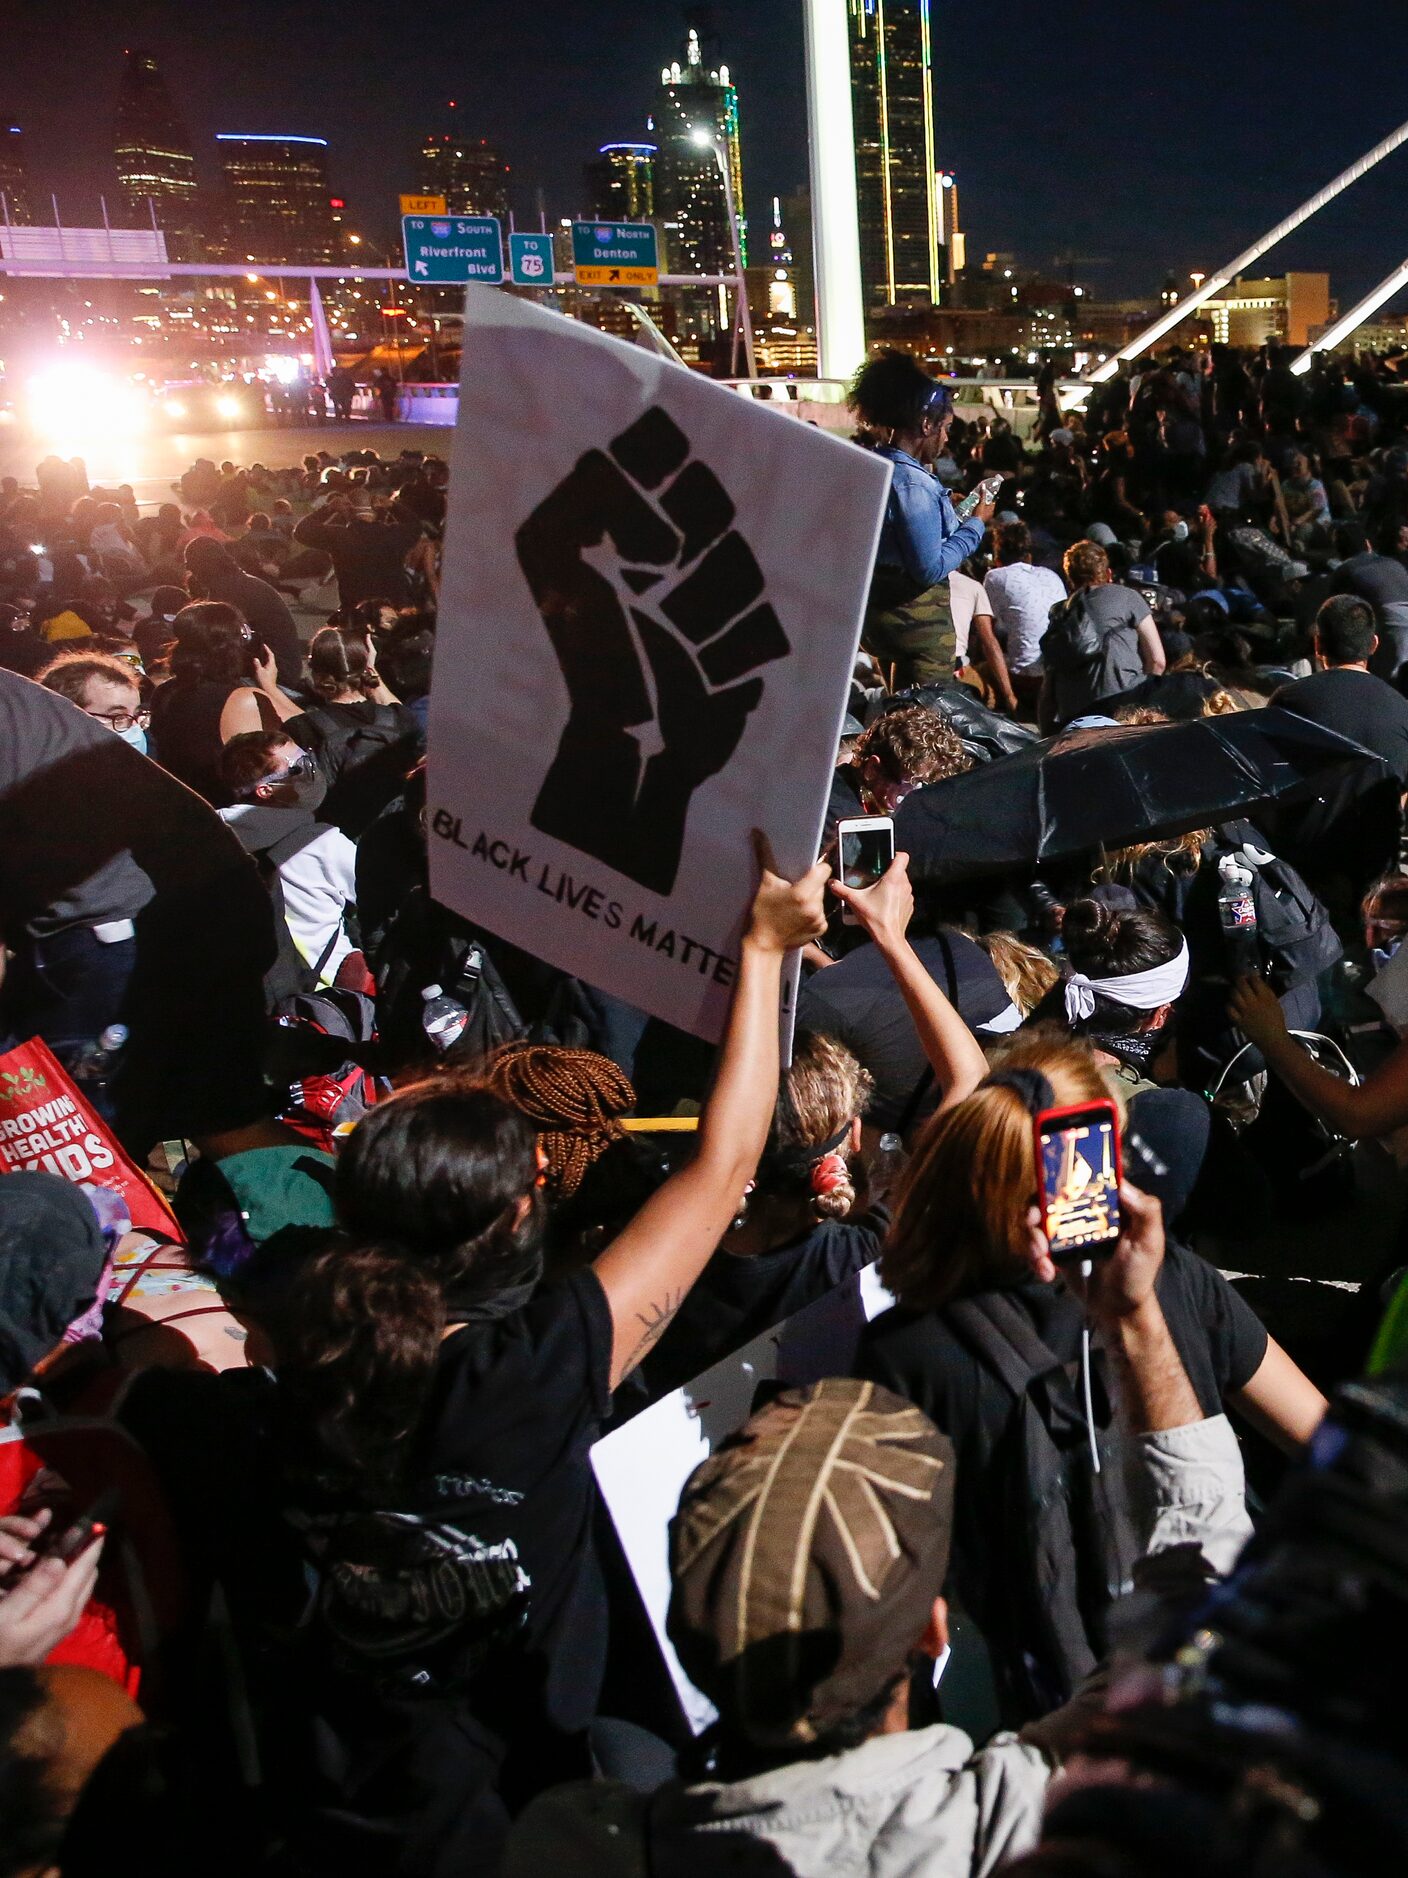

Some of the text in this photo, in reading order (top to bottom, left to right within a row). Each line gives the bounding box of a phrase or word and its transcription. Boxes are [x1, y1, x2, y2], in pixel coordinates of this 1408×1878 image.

[409, 200, 437, 210] LEFT
[411, 220, 425, 230] TO
[456, 221, 493, 235] SOUTH
[578, 226, 591, 236] TO
[616, 227, 650, 240] NORTH
[420, 245, 488, 259] Riverfront
[523, 240, 539, 251] TO
[593, 247, 638, 260] Denton
[467, 262, 497, 275] Blvd
[524, 259, 542, 272] 75
[578, 270, 655, 281] EXIT ONLY
[432, 808, 533, 882] BLACK
[536, 864, 624, 930] LIVES
[10, 1133, 115, 1182] IDS
